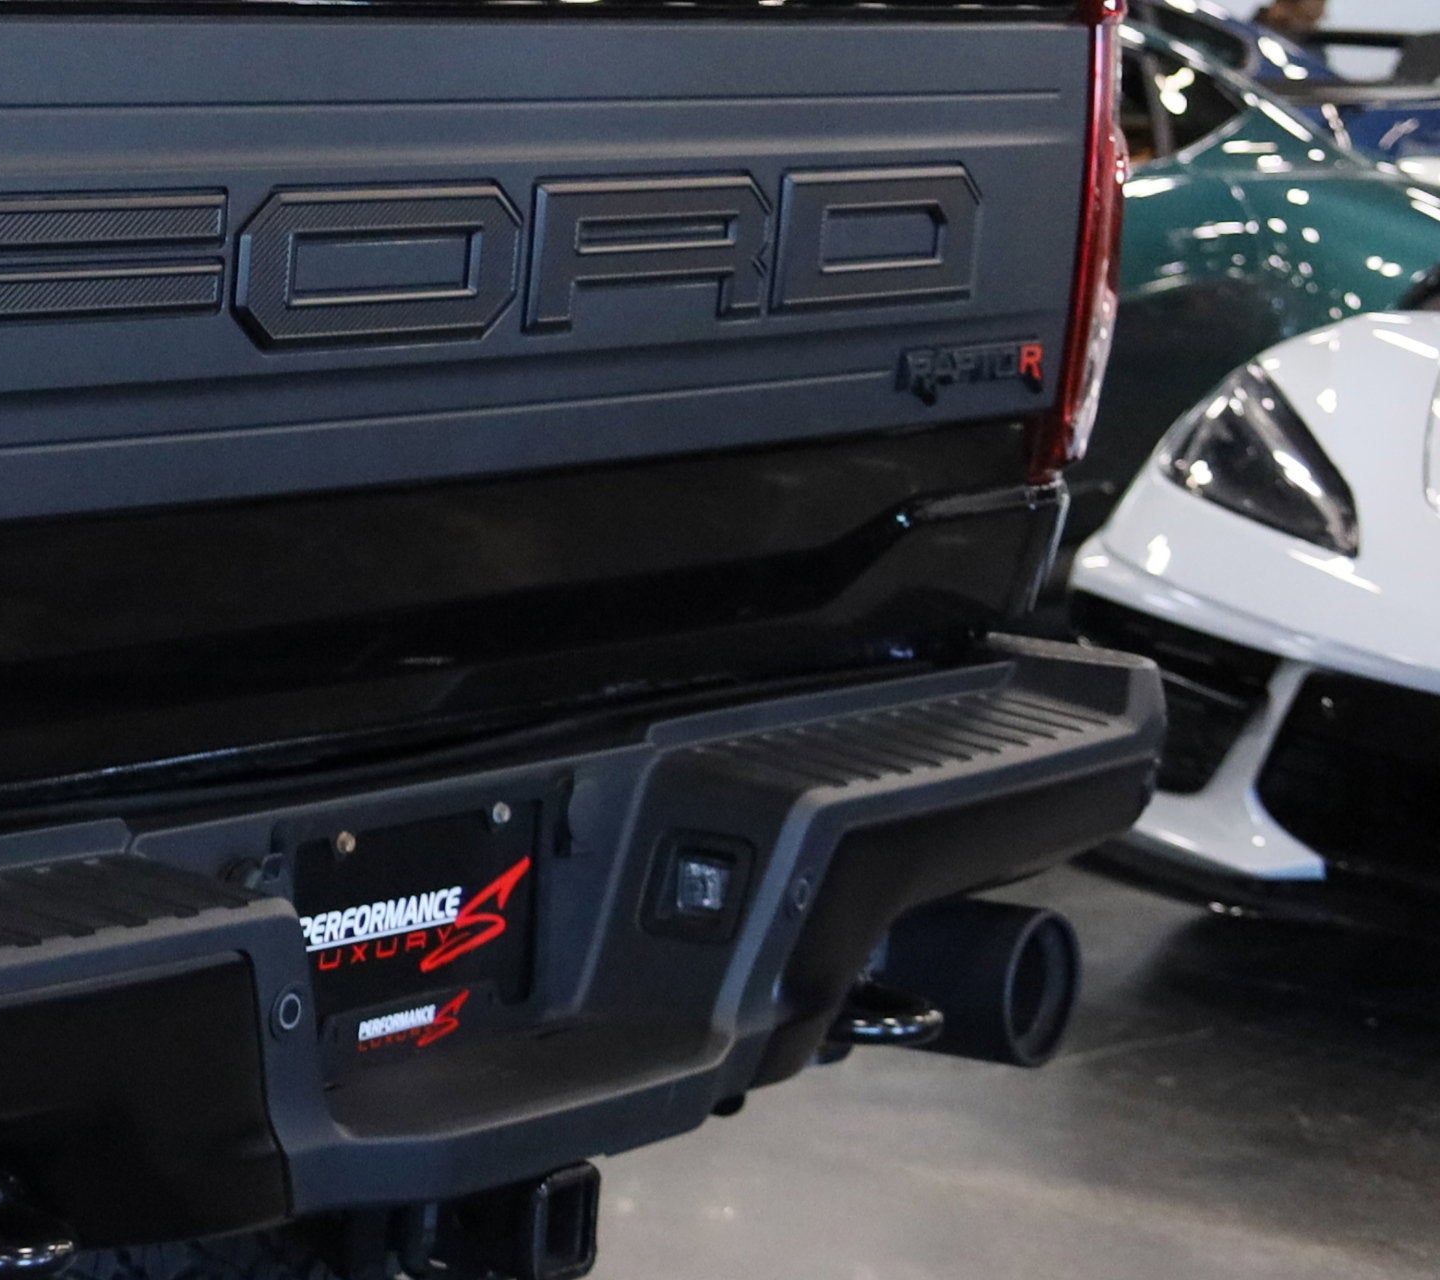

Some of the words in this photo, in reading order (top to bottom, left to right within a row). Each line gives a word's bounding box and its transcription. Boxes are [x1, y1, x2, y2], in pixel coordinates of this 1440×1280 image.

[895, 337, 1044, 407] RAPTOR
[300, 886, 462, 945] PERFORMANCE
[318, 925, 452, 970] UXURY
